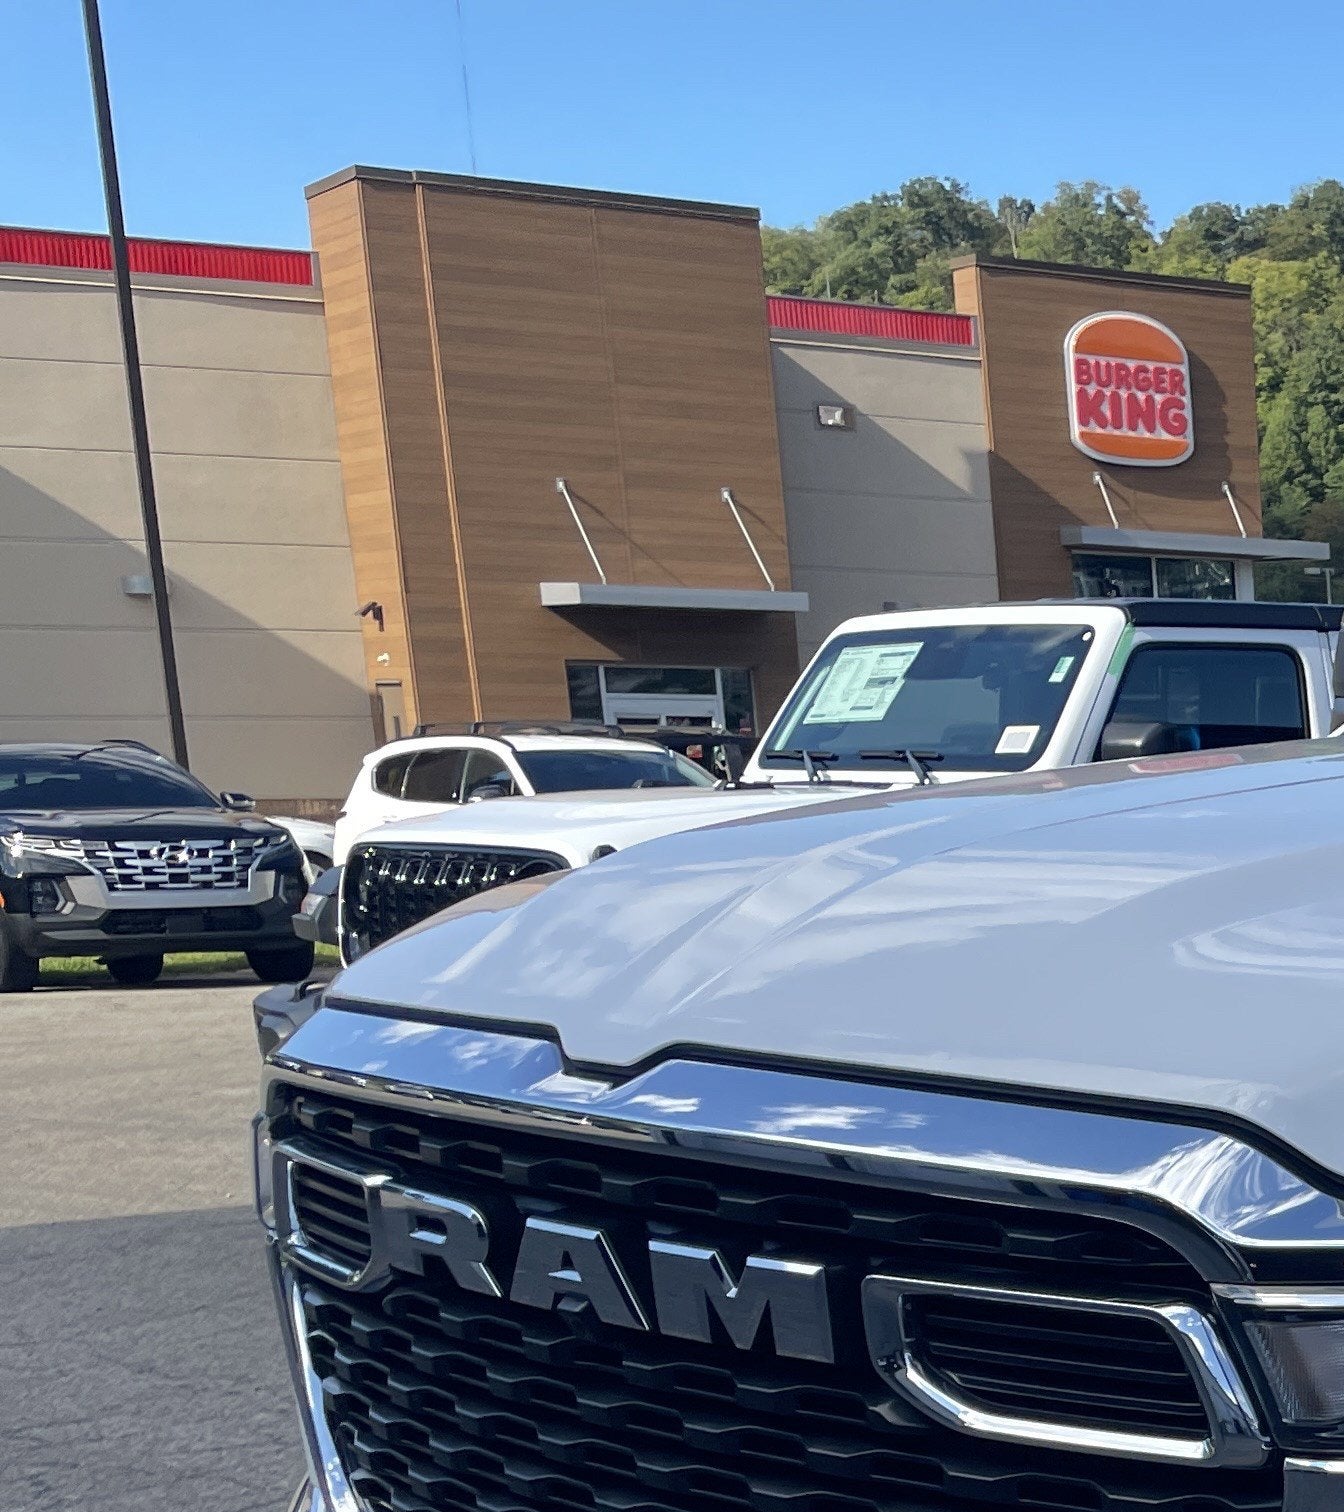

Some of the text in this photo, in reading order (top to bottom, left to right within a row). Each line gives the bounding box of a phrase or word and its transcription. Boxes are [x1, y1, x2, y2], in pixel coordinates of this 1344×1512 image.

[1074, 358, 1186, 396] BURGER
[1076, 386, 1188, 436] KING
[368, 1176, 835, 1364] RAM
